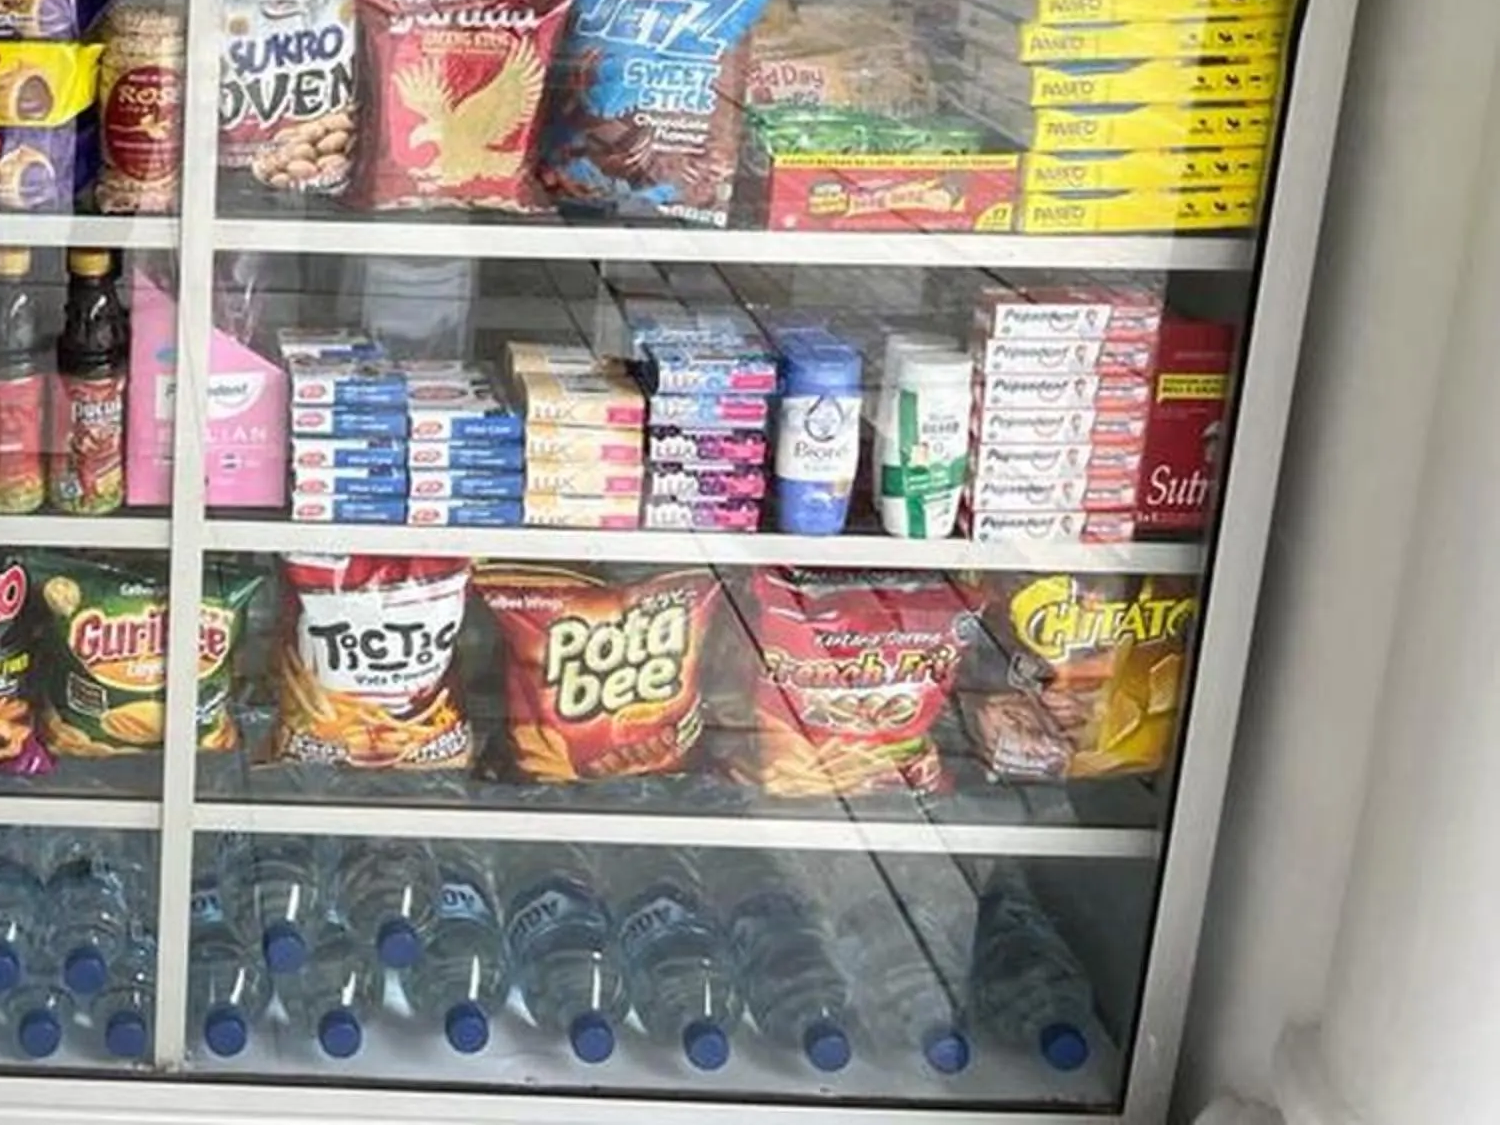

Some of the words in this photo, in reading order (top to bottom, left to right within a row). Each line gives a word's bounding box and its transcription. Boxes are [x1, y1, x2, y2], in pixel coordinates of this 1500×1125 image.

[229, 26, 344, 73] SUKRO
[217, 65, 353, 125] OVEN
[1146, 464, 1209, 506] Sutr
[547, 606, 686, 682] Pota
[559, 657, 678, 718] bee
